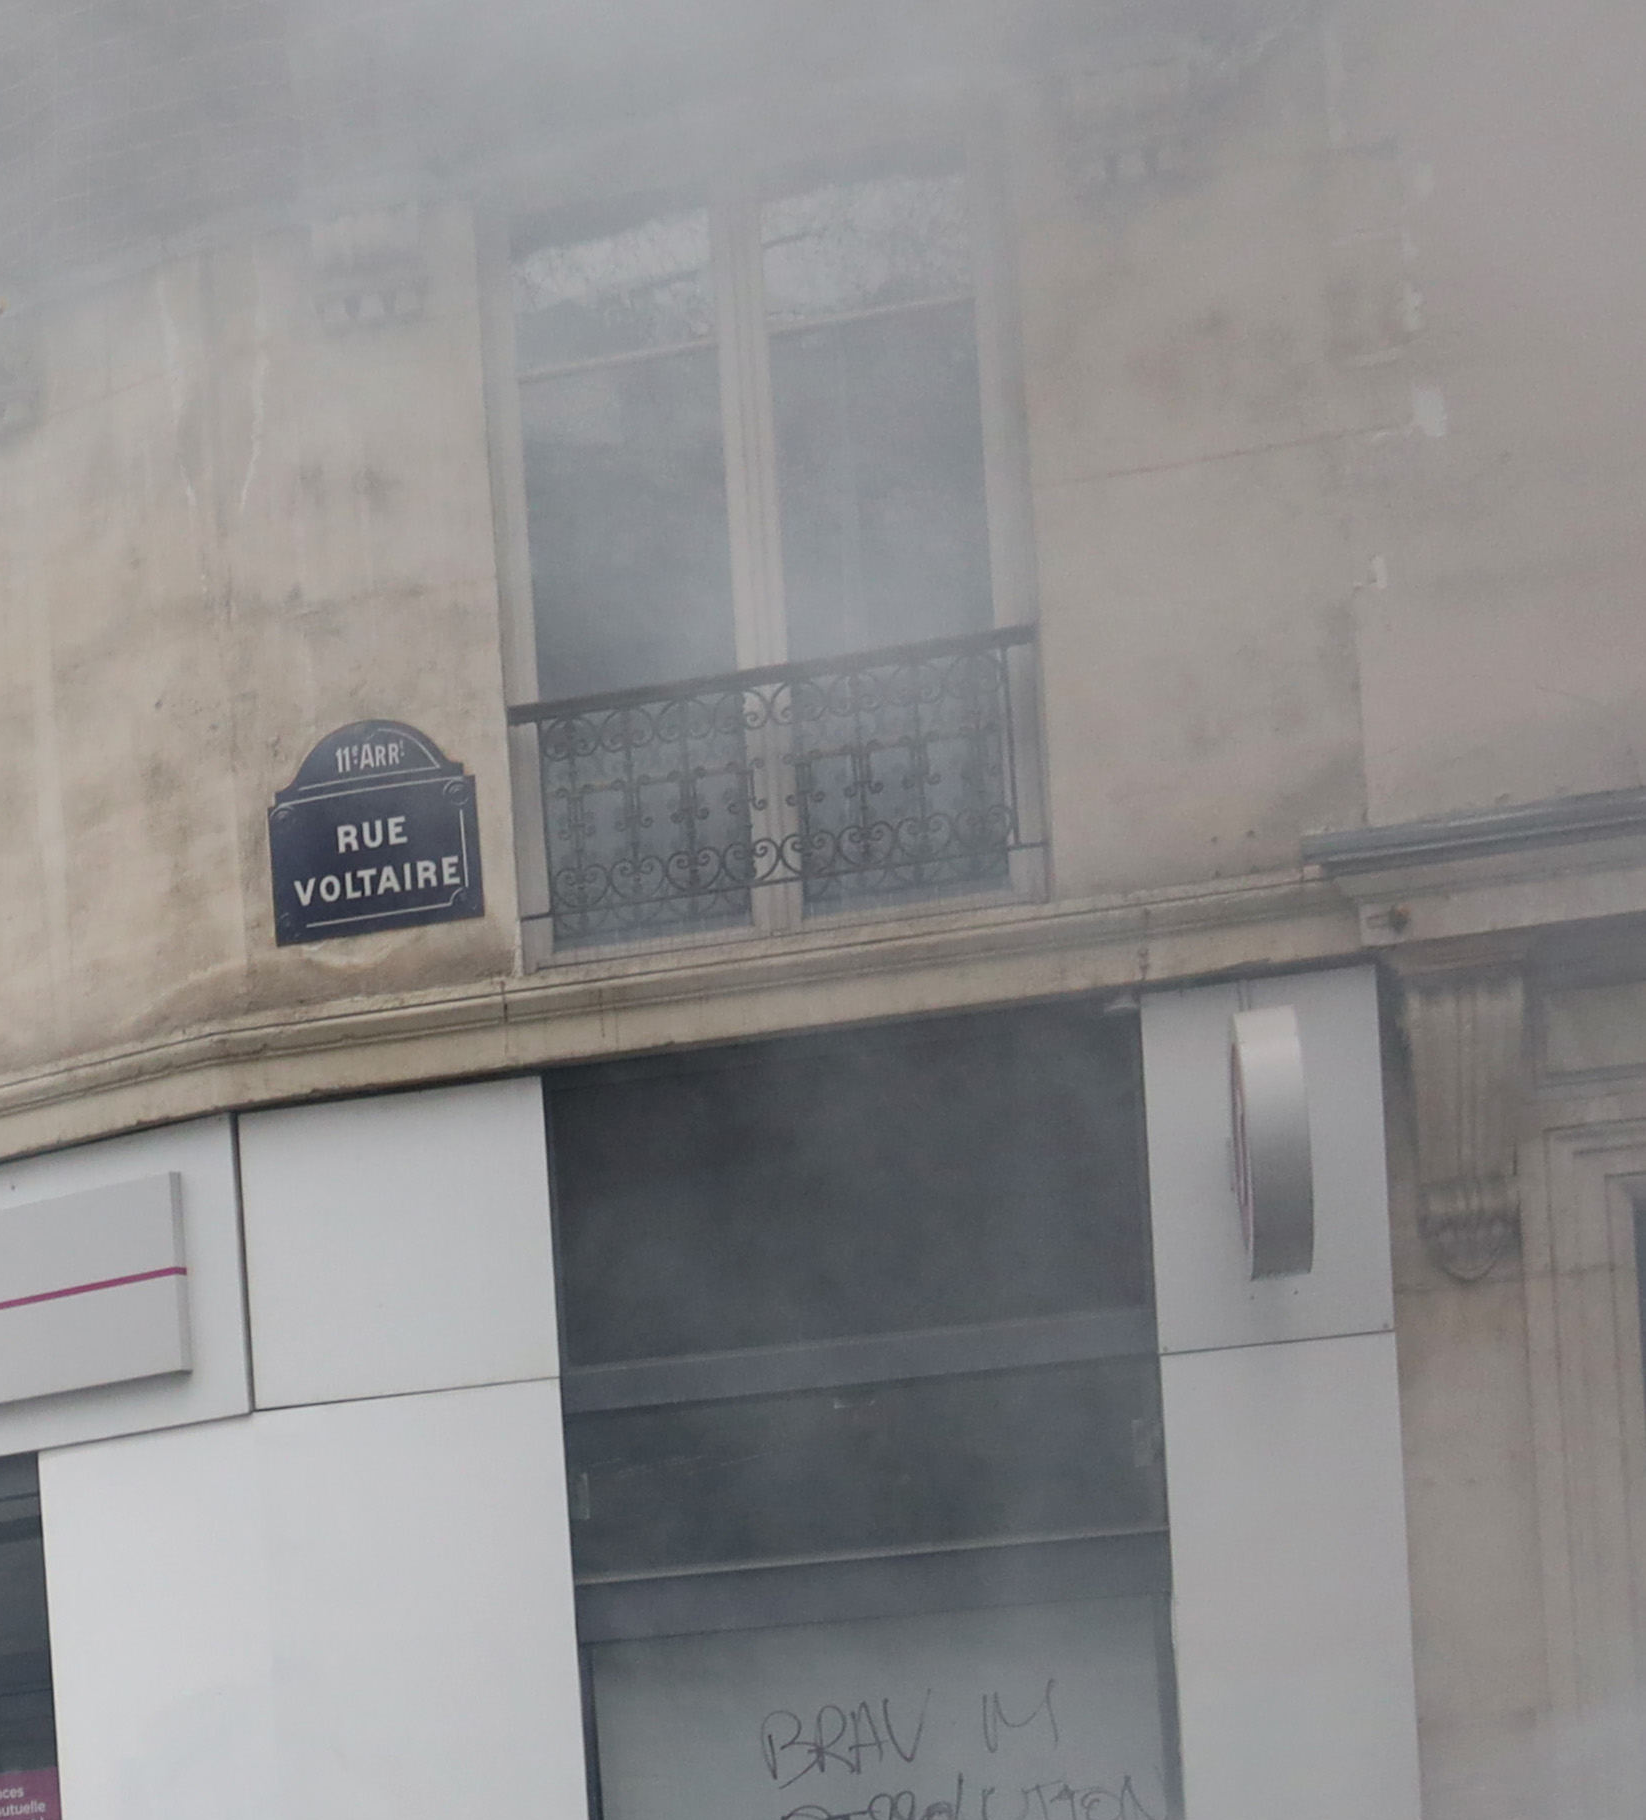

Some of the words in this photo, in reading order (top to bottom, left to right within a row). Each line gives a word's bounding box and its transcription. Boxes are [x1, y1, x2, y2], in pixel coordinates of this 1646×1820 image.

[336, 815, 408, 854] RUE
[293, 855, 461, 907] VOLTAIRE
[759, 1689, 932, 1789] BRAV
[982, 1679, 1060, 1753] M
